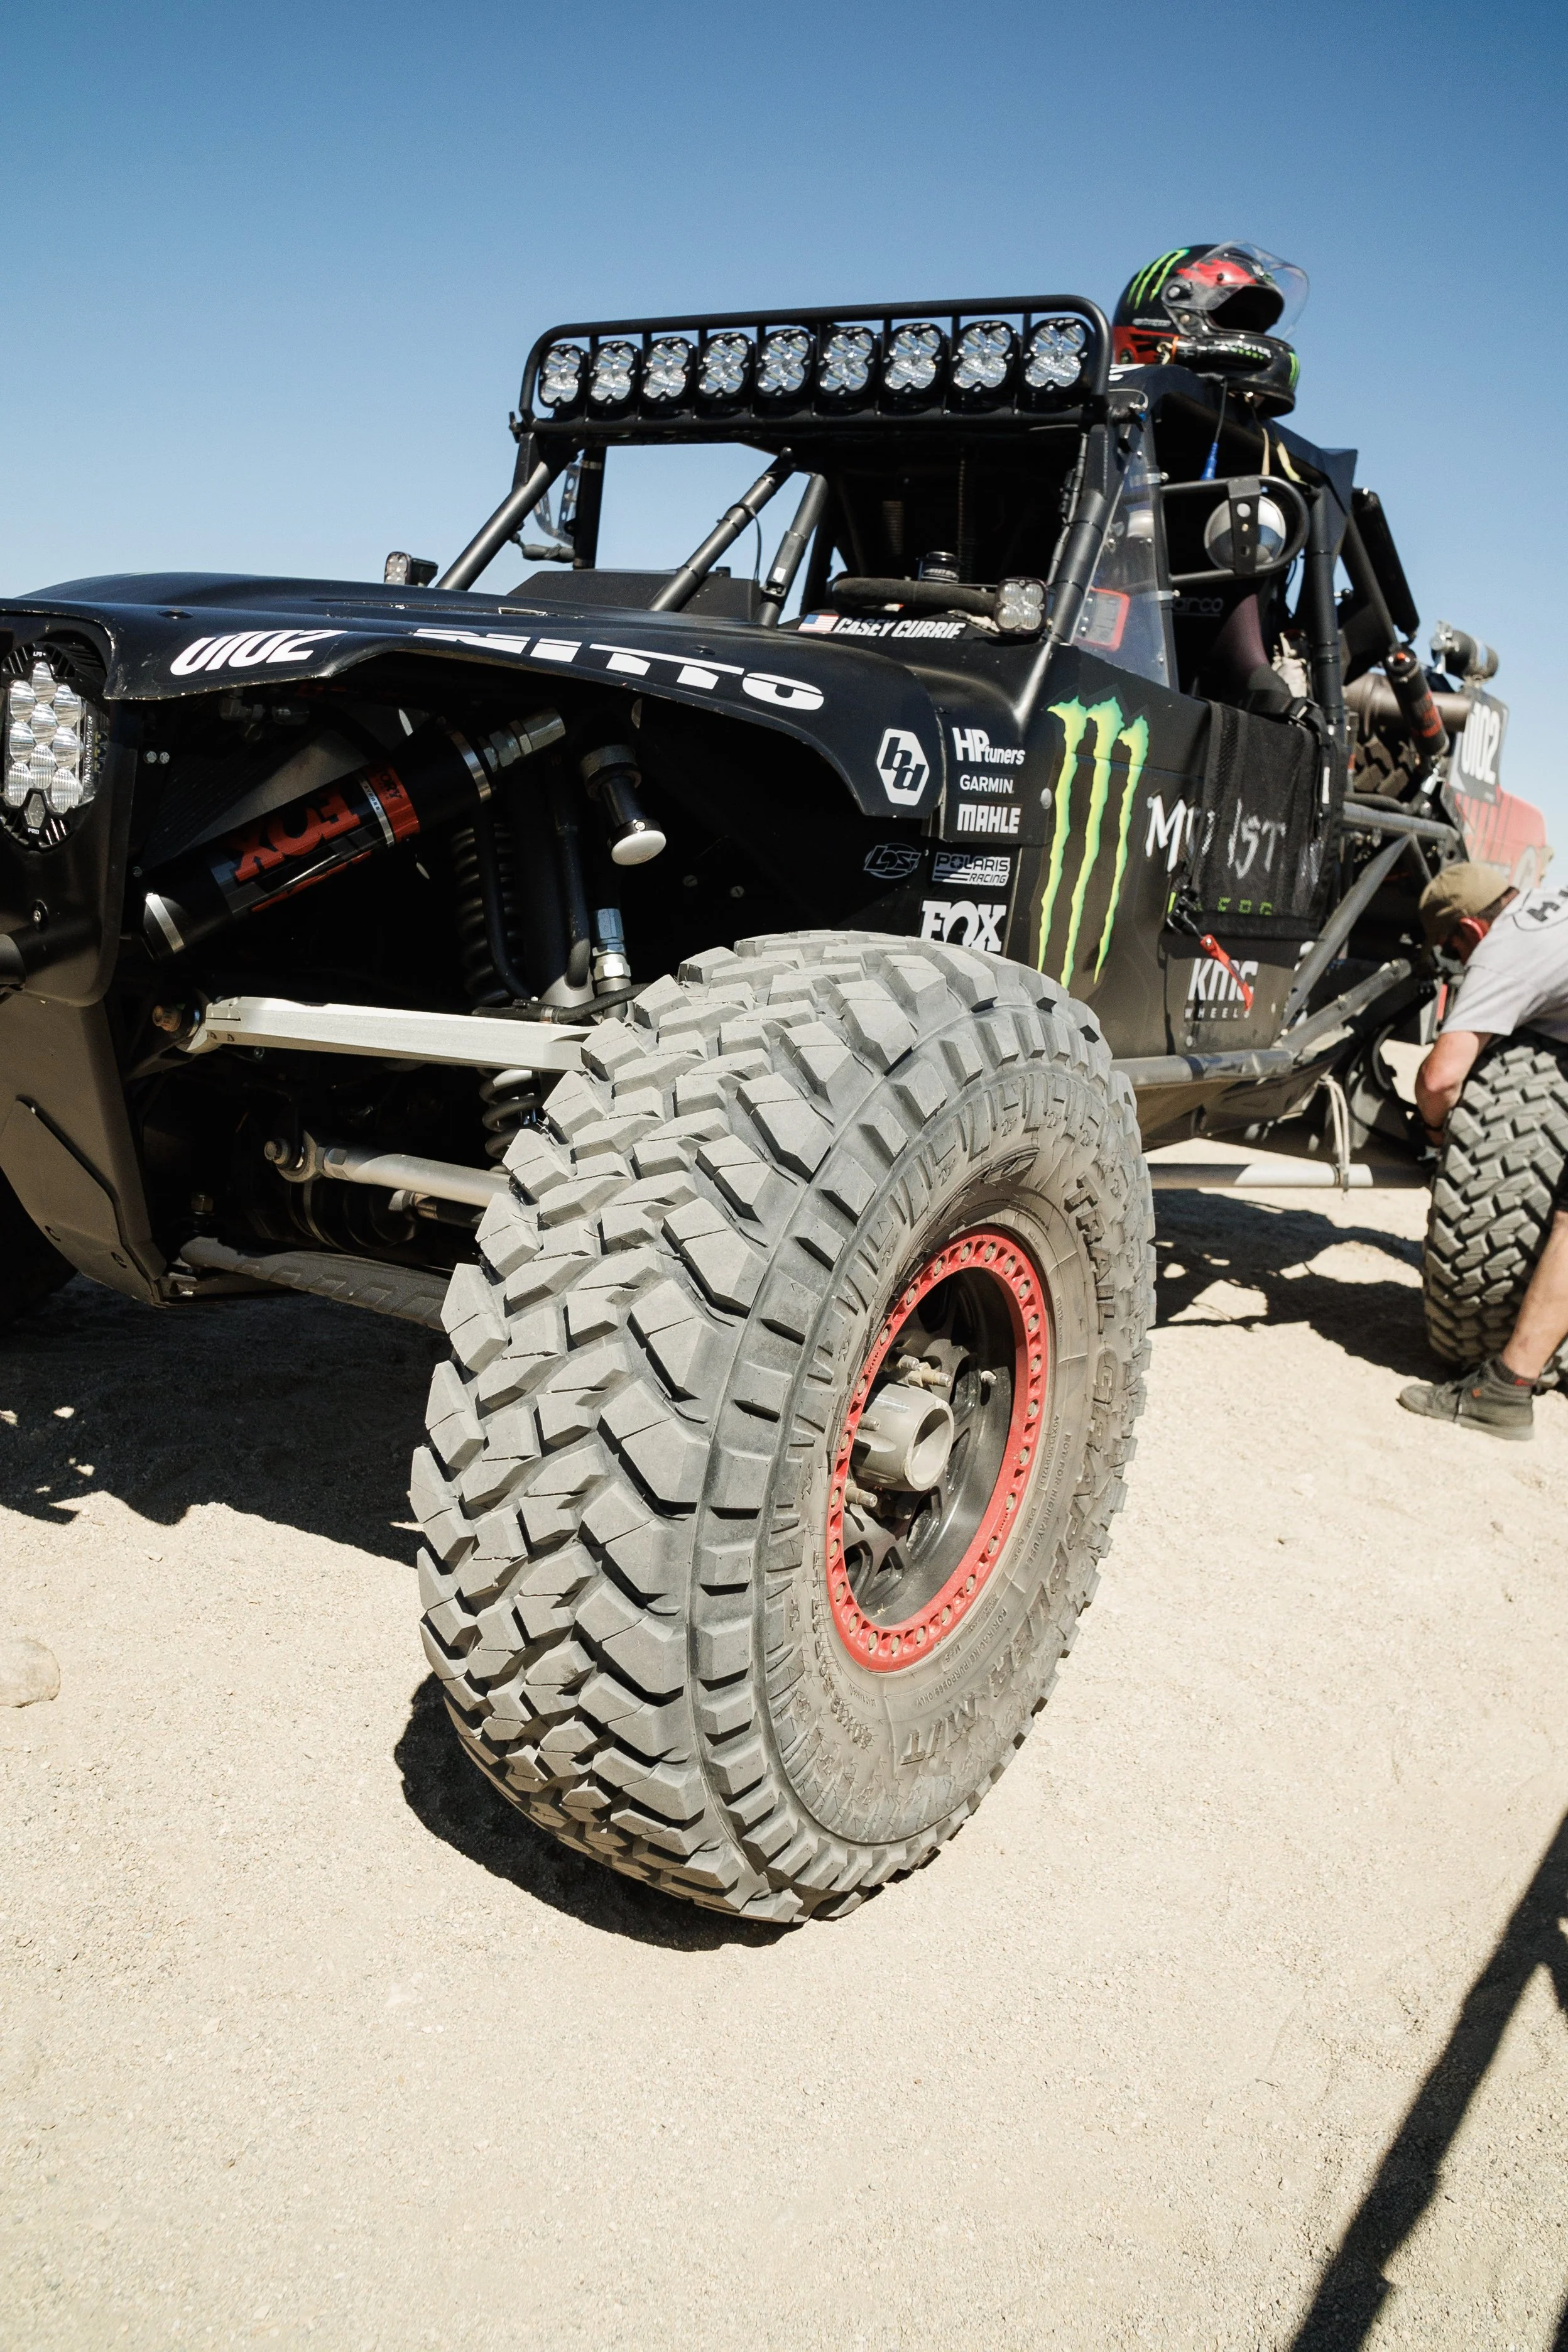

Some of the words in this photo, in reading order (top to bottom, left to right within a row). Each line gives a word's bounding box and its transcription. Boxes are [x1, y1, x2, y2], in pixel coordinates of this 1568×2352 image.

[833, 617, 896, 637] CASEY
[170, 629, 348, 675] U102
[413, 628, 824, 710] NITTO
[1461, 701, 1500, 785] U102
[959, 774, 1015, 794] GARMIN
[957, 803, 1021, 834] MAHLE
[936, 853, 1009, 872] POLARIS
[969, 873, 1008, 884] RACING
[920, 900, 1007, 952] FOX
[1054, 1459, 1067, 1486] FOR
[1026, 1542, 1040, 1564] USE
[993, 1608, 1008, 1630] FOR
